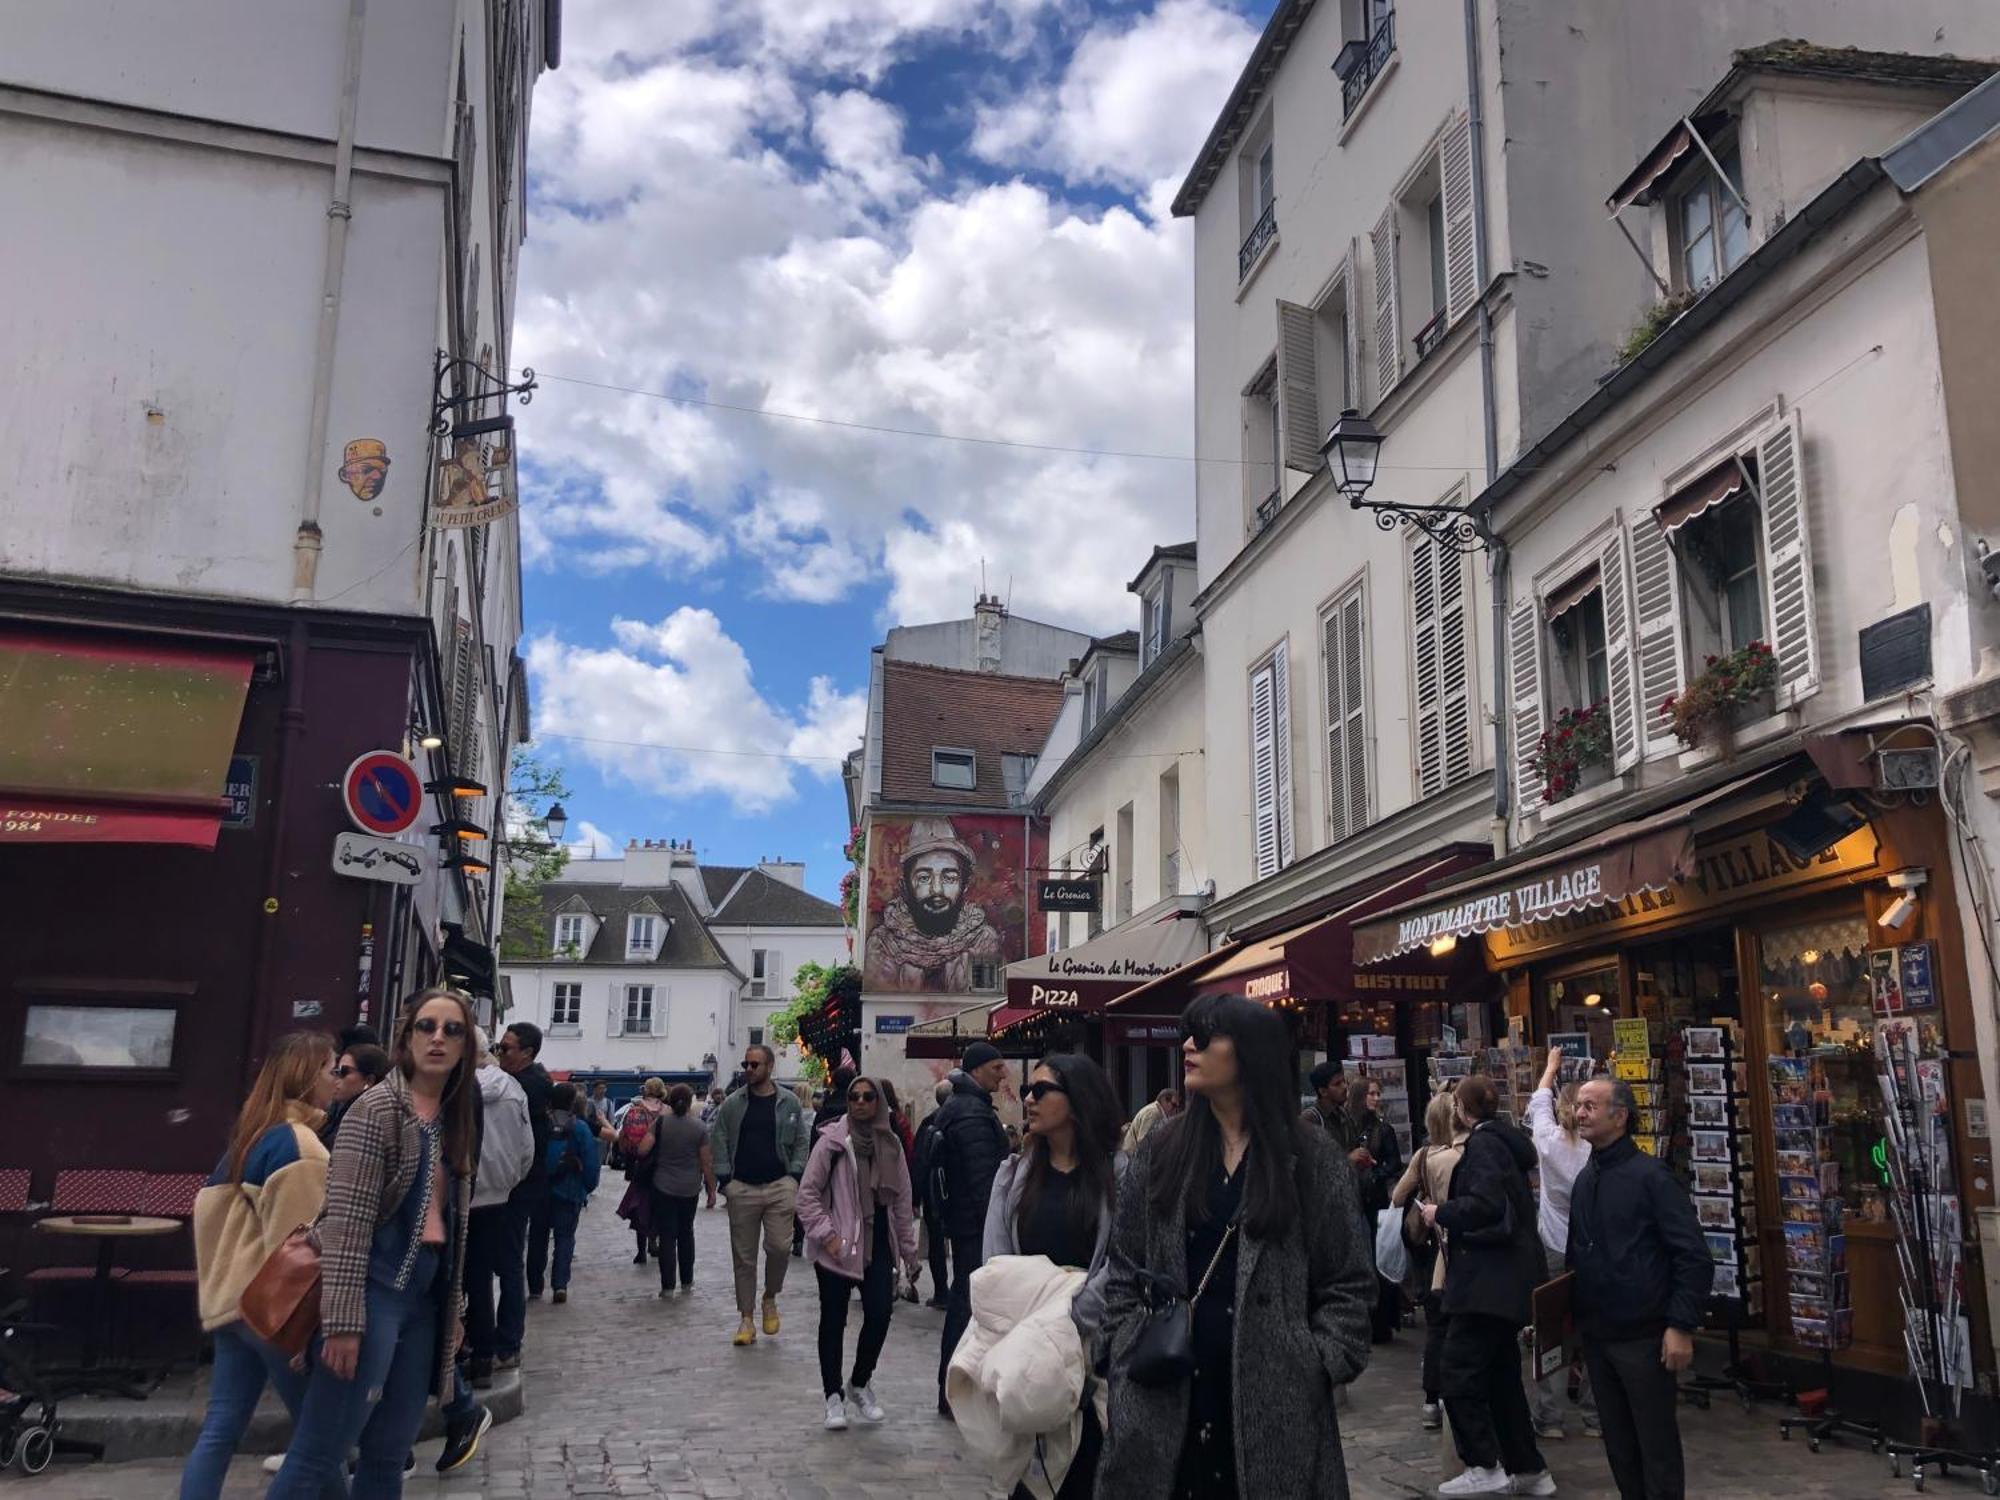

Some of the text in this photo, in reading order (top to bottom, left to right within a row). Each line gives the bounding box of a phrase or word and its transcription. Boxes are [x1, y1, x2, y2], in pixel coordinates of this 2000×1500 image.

[1696, 839, 1840, 896] VILLAE
[1043, 886, 1092, 900] Le Grenier
[1398, 865, 1601, 945] MONTMARTRE VILLAGE
[1049, 956, 1060, 973] Le
[1062, 957, 1106, 976] Grenier
[1108, 960, 1121, 976] de
[1353, 974, 1449, 990] BISTROT
[1031, 984, 1079, 1007] PIZZA
